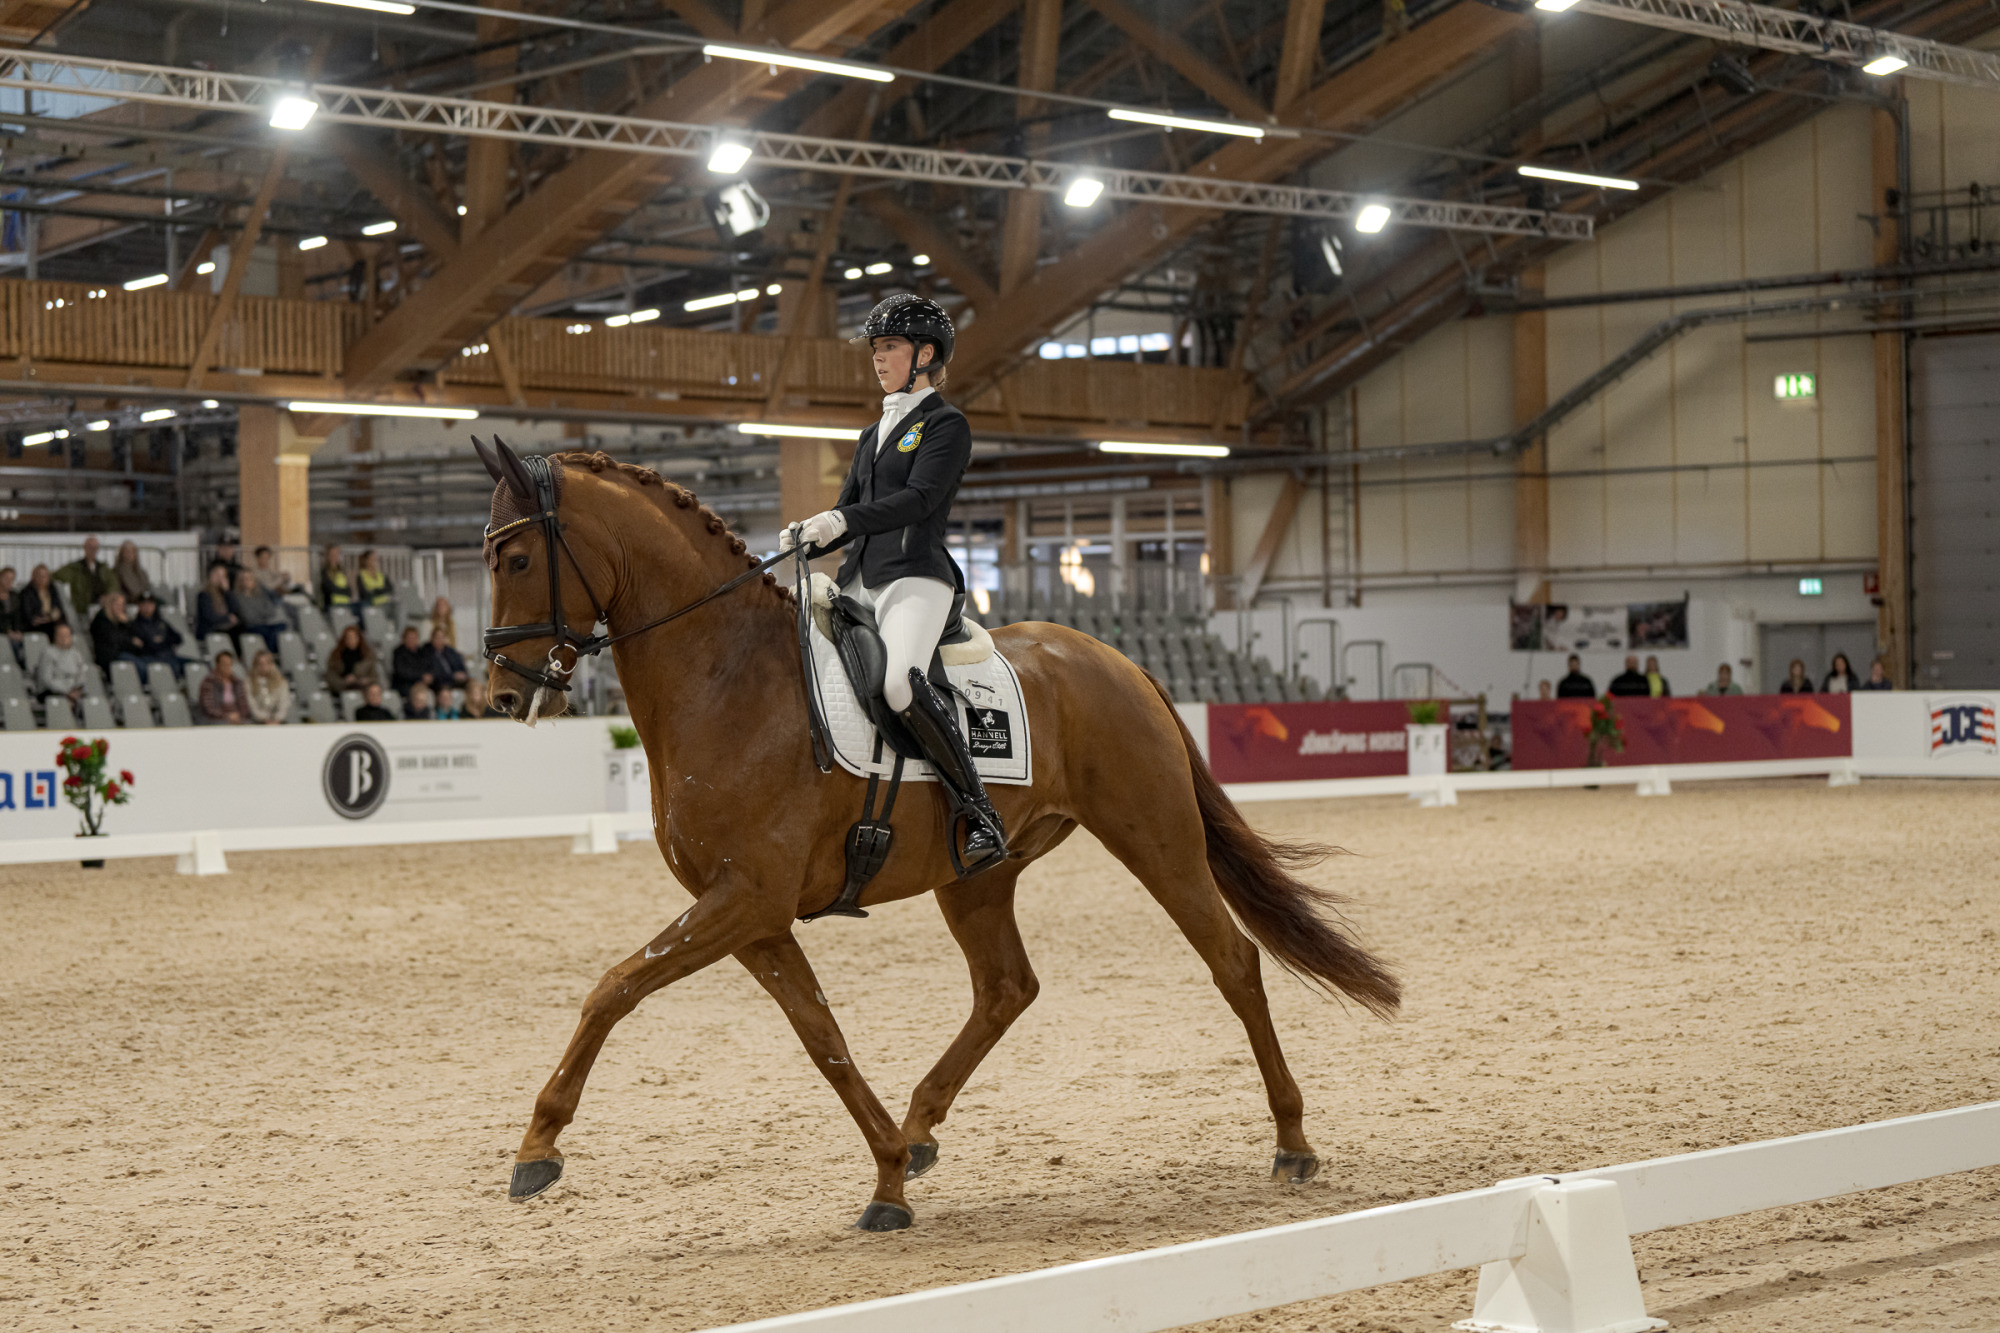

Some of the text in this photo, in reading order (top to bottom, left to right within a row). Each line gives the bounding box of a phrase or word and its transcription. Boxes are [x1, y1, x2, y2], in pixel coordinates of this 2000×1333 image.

[965, 688, 1003, 706] 0941
[971, 730, 1008, 740] HANNELL
[609, 762, 621, 781] P
[632, 761, 645, 781] P
